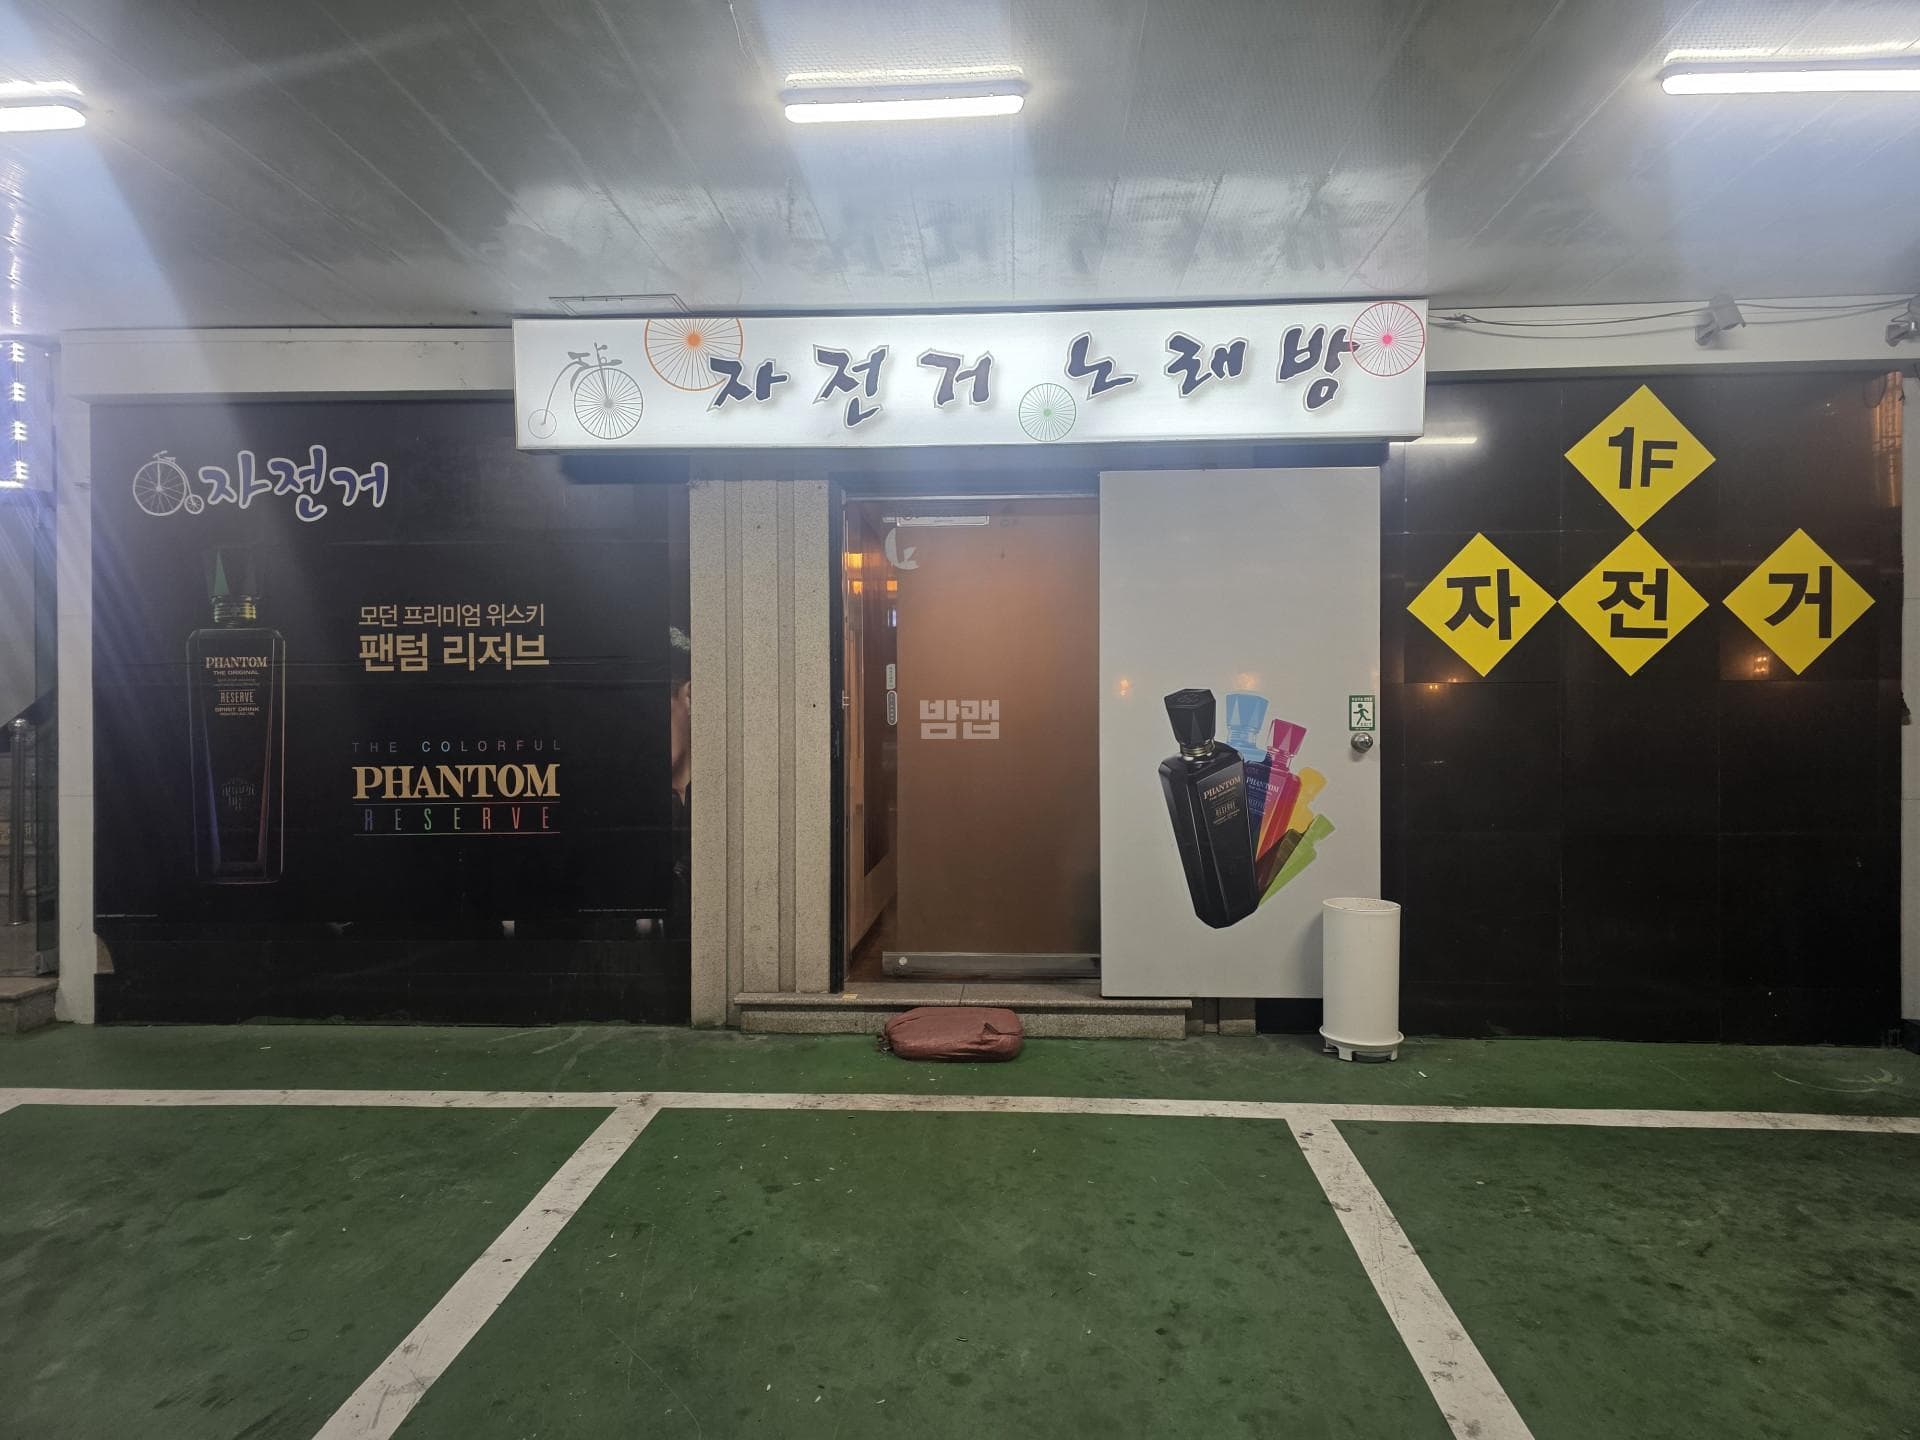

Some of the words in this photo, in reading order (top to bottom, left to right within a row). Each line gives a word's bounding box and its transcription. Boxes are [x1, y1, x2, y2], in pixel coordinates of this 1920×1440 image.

[706, 344, 993, 428] 자전거
[1063, 322, 1361, 412] 노래방
[1607, 426, 1678, 490] 1F
[198, 444, 390, 522] 자전거
[358, 604, 398, 627] 모던
[402, 603, 481, 627] 프리미엄
[486, 603, 545, 627] 위스키
[1443, 565, 1834, 642] 자전거
[205, 656, 268, 669] PHANTOM
[359, 632, 428, 672] 팬텀
[443, 632, 550, 672] 리저브
[220, 691, 254, 703] RESERVE
[352, 742, 398, 753] THE
[421, 739, 561, 752] COLORFUL
[352, 763, 561, 799] PHANTOM
[1203, 775, 1242, 800] PHANTOM
[364, 806, 550, 831] RESERVE
